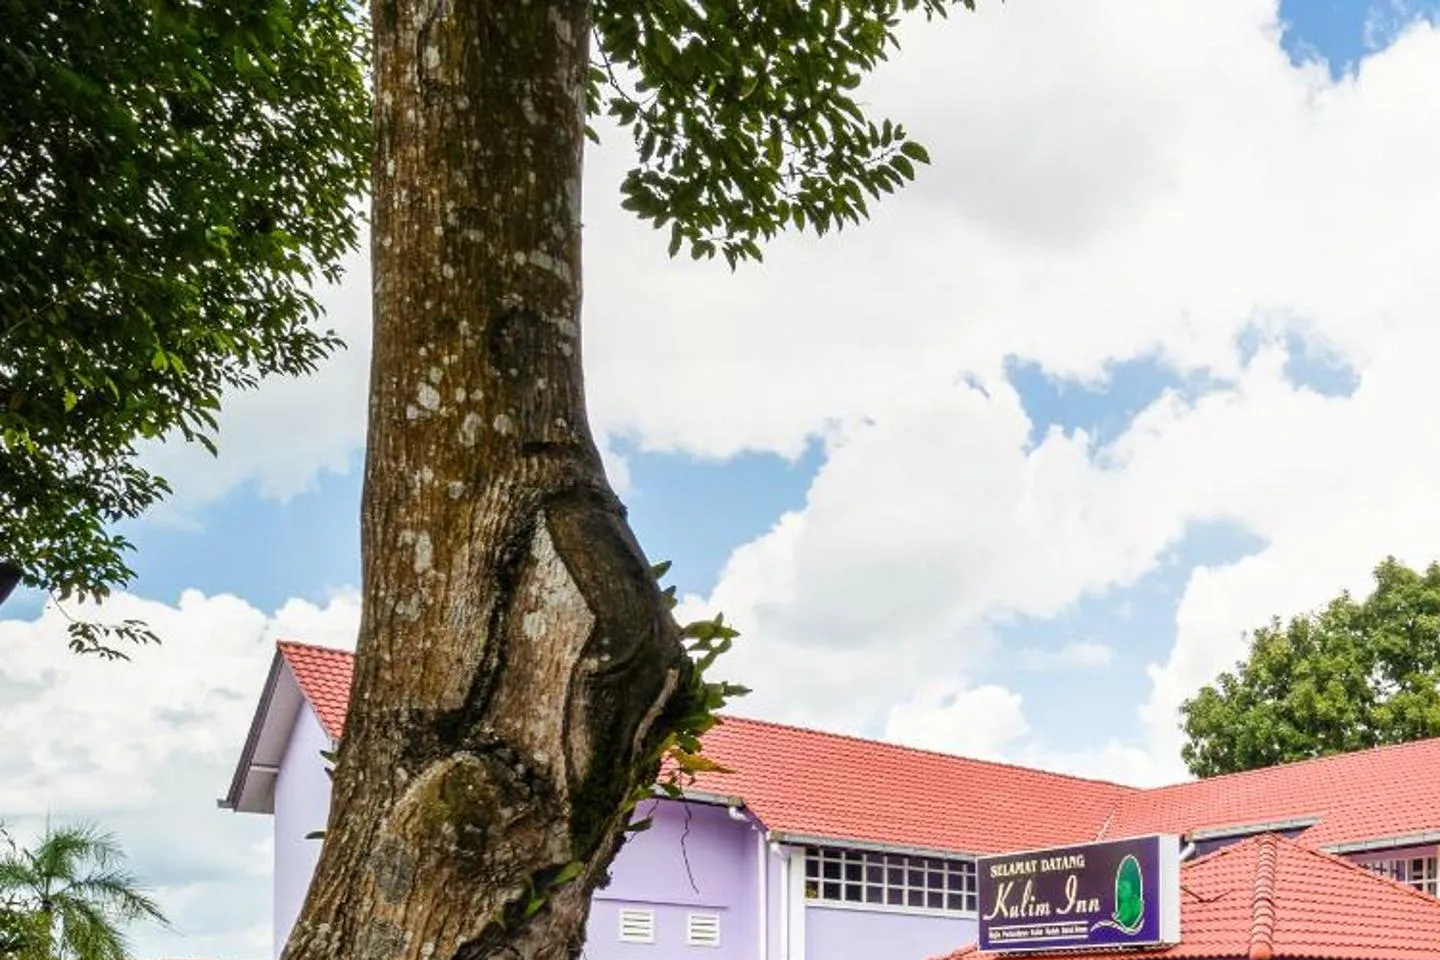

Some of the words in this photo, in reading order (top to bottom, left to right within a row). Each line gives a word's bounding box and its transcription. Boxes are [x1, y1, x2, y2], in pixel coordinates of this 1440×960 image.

[990, 859, 1038, 878] SELAMAT
[1041, 854, 1086, 872] DATANG
[982, 879, 1050, 920] Kulim
[1056, 874, 1101, 915] Inn
